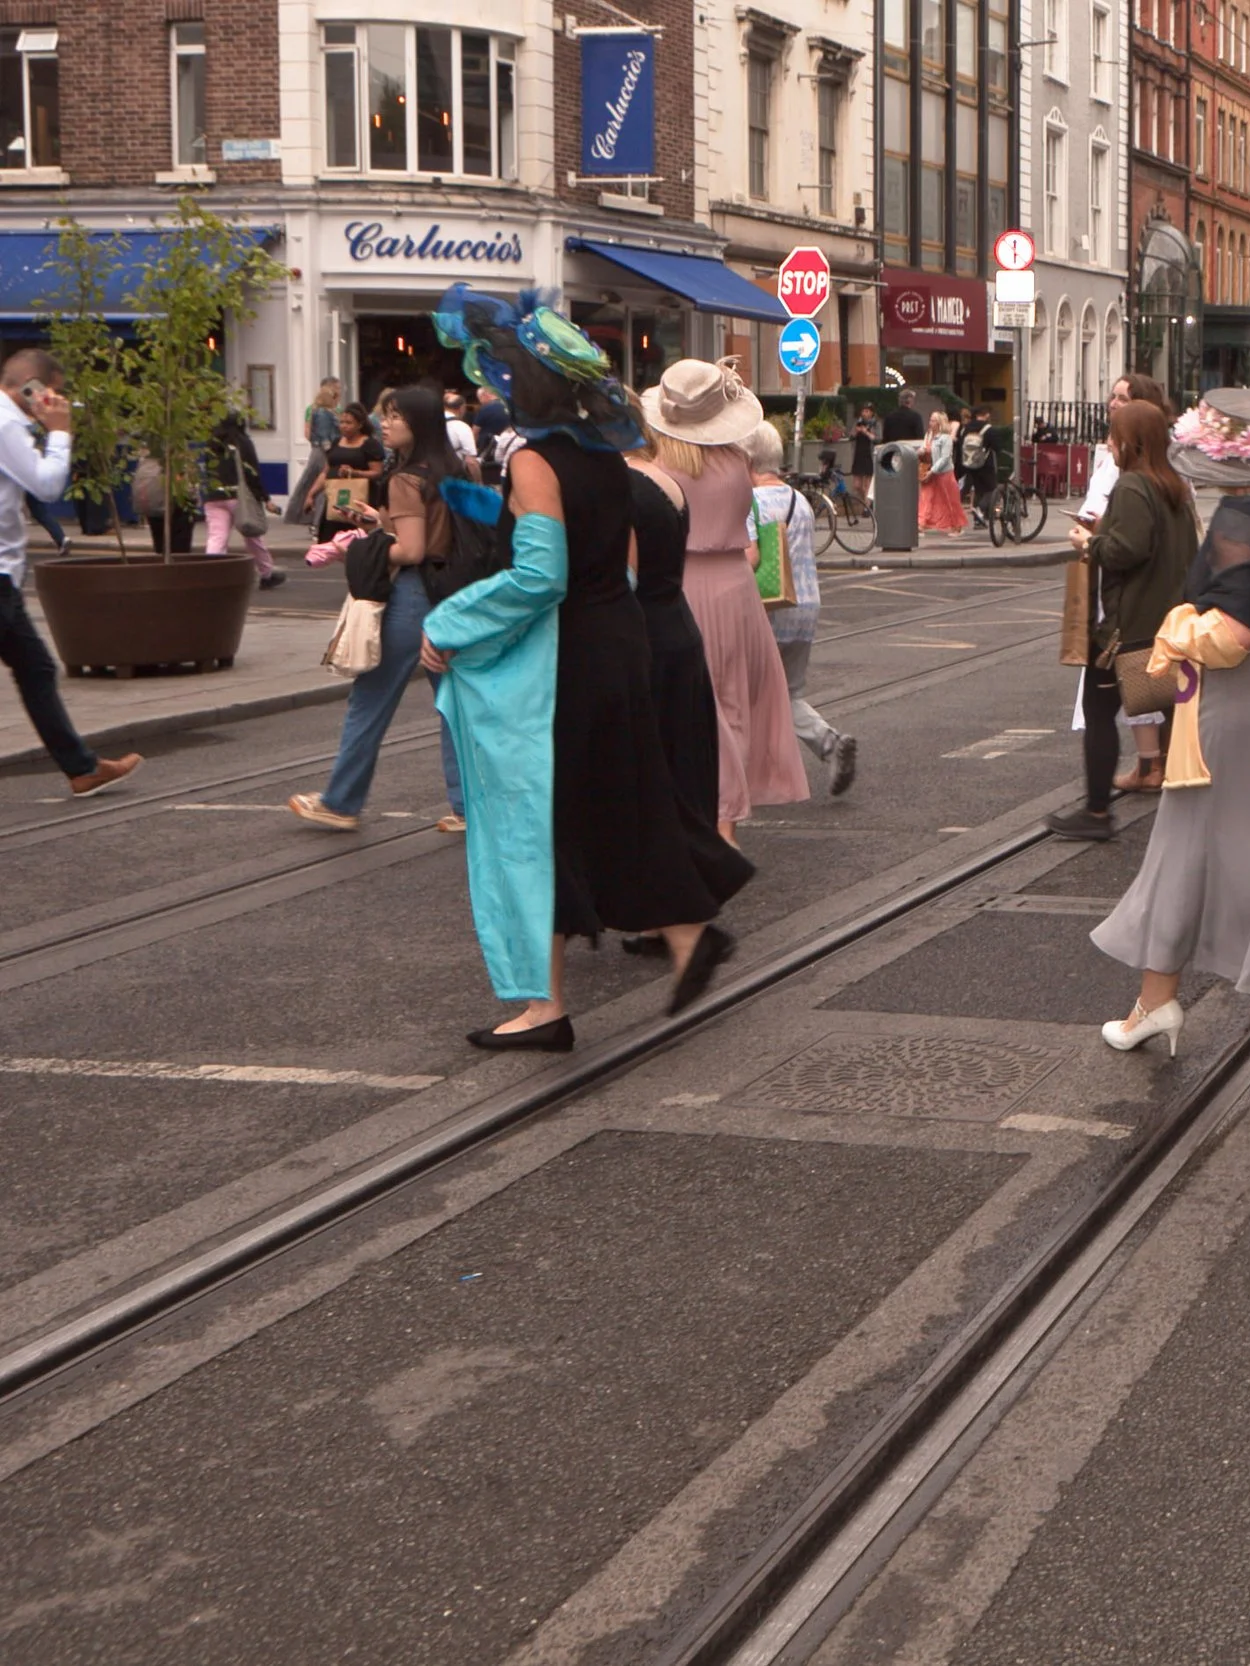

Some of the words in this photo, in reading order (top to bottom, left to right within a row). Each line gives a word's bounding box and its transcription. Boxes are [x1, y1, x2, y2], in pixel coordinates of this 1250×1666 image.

[591, 48, 646, 161] Carluccio's
[344, 221, 523, 263] Carluccio's
[781, 269, 828, 296] STOP
[900, 300, 920, 314] PRET
[937, 296, 965, 326] MANGER
